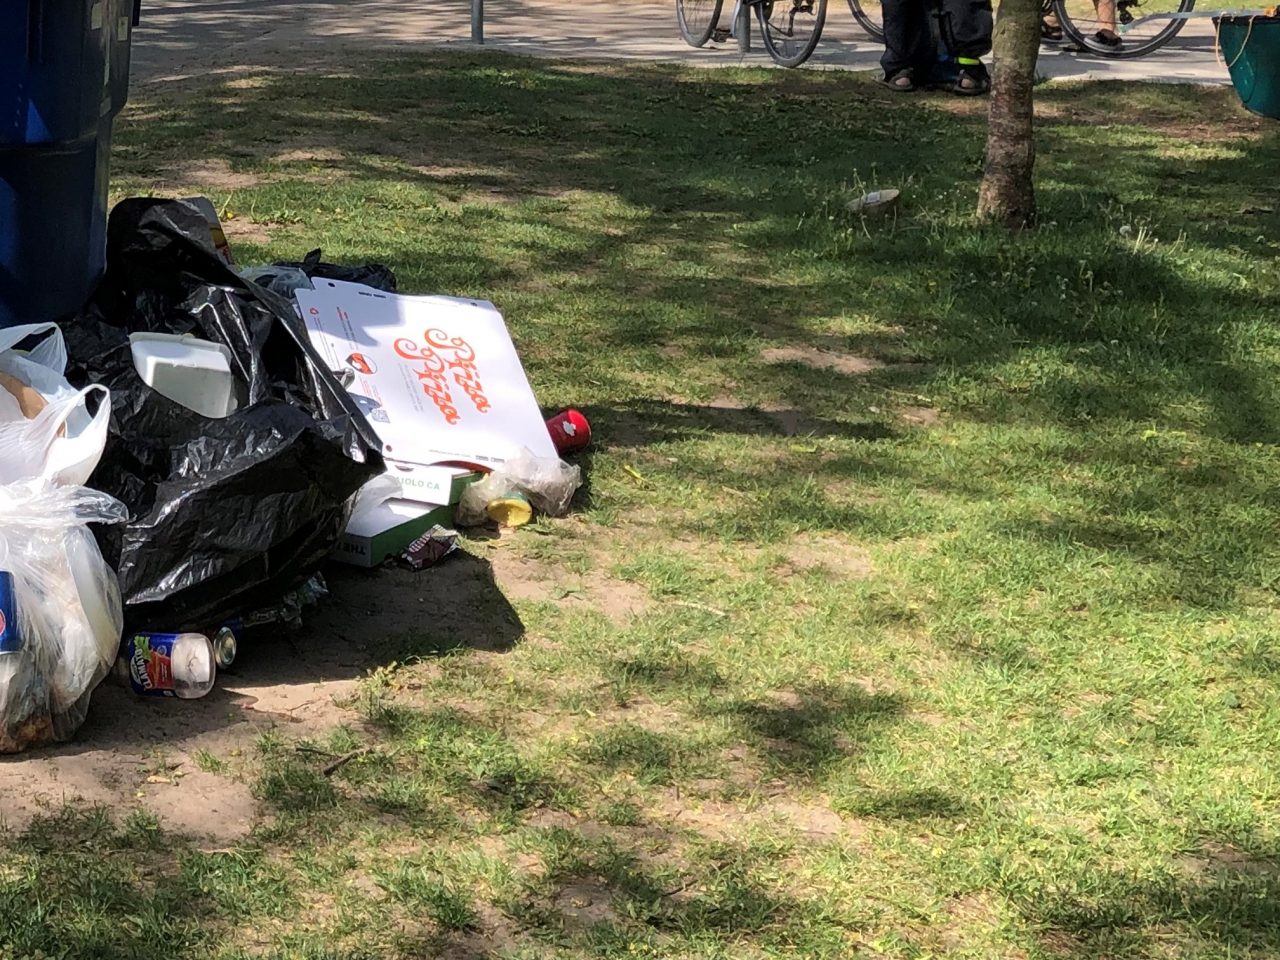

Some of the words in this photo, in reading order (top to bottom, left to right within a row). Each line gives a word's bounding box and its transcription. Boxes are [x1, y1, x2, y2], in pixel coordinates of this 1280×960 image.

[394, 338, 461, 425] Pizza
[424, 328, 491, 413] Pizza
[134, 648, 153, 689] CLAMATO
